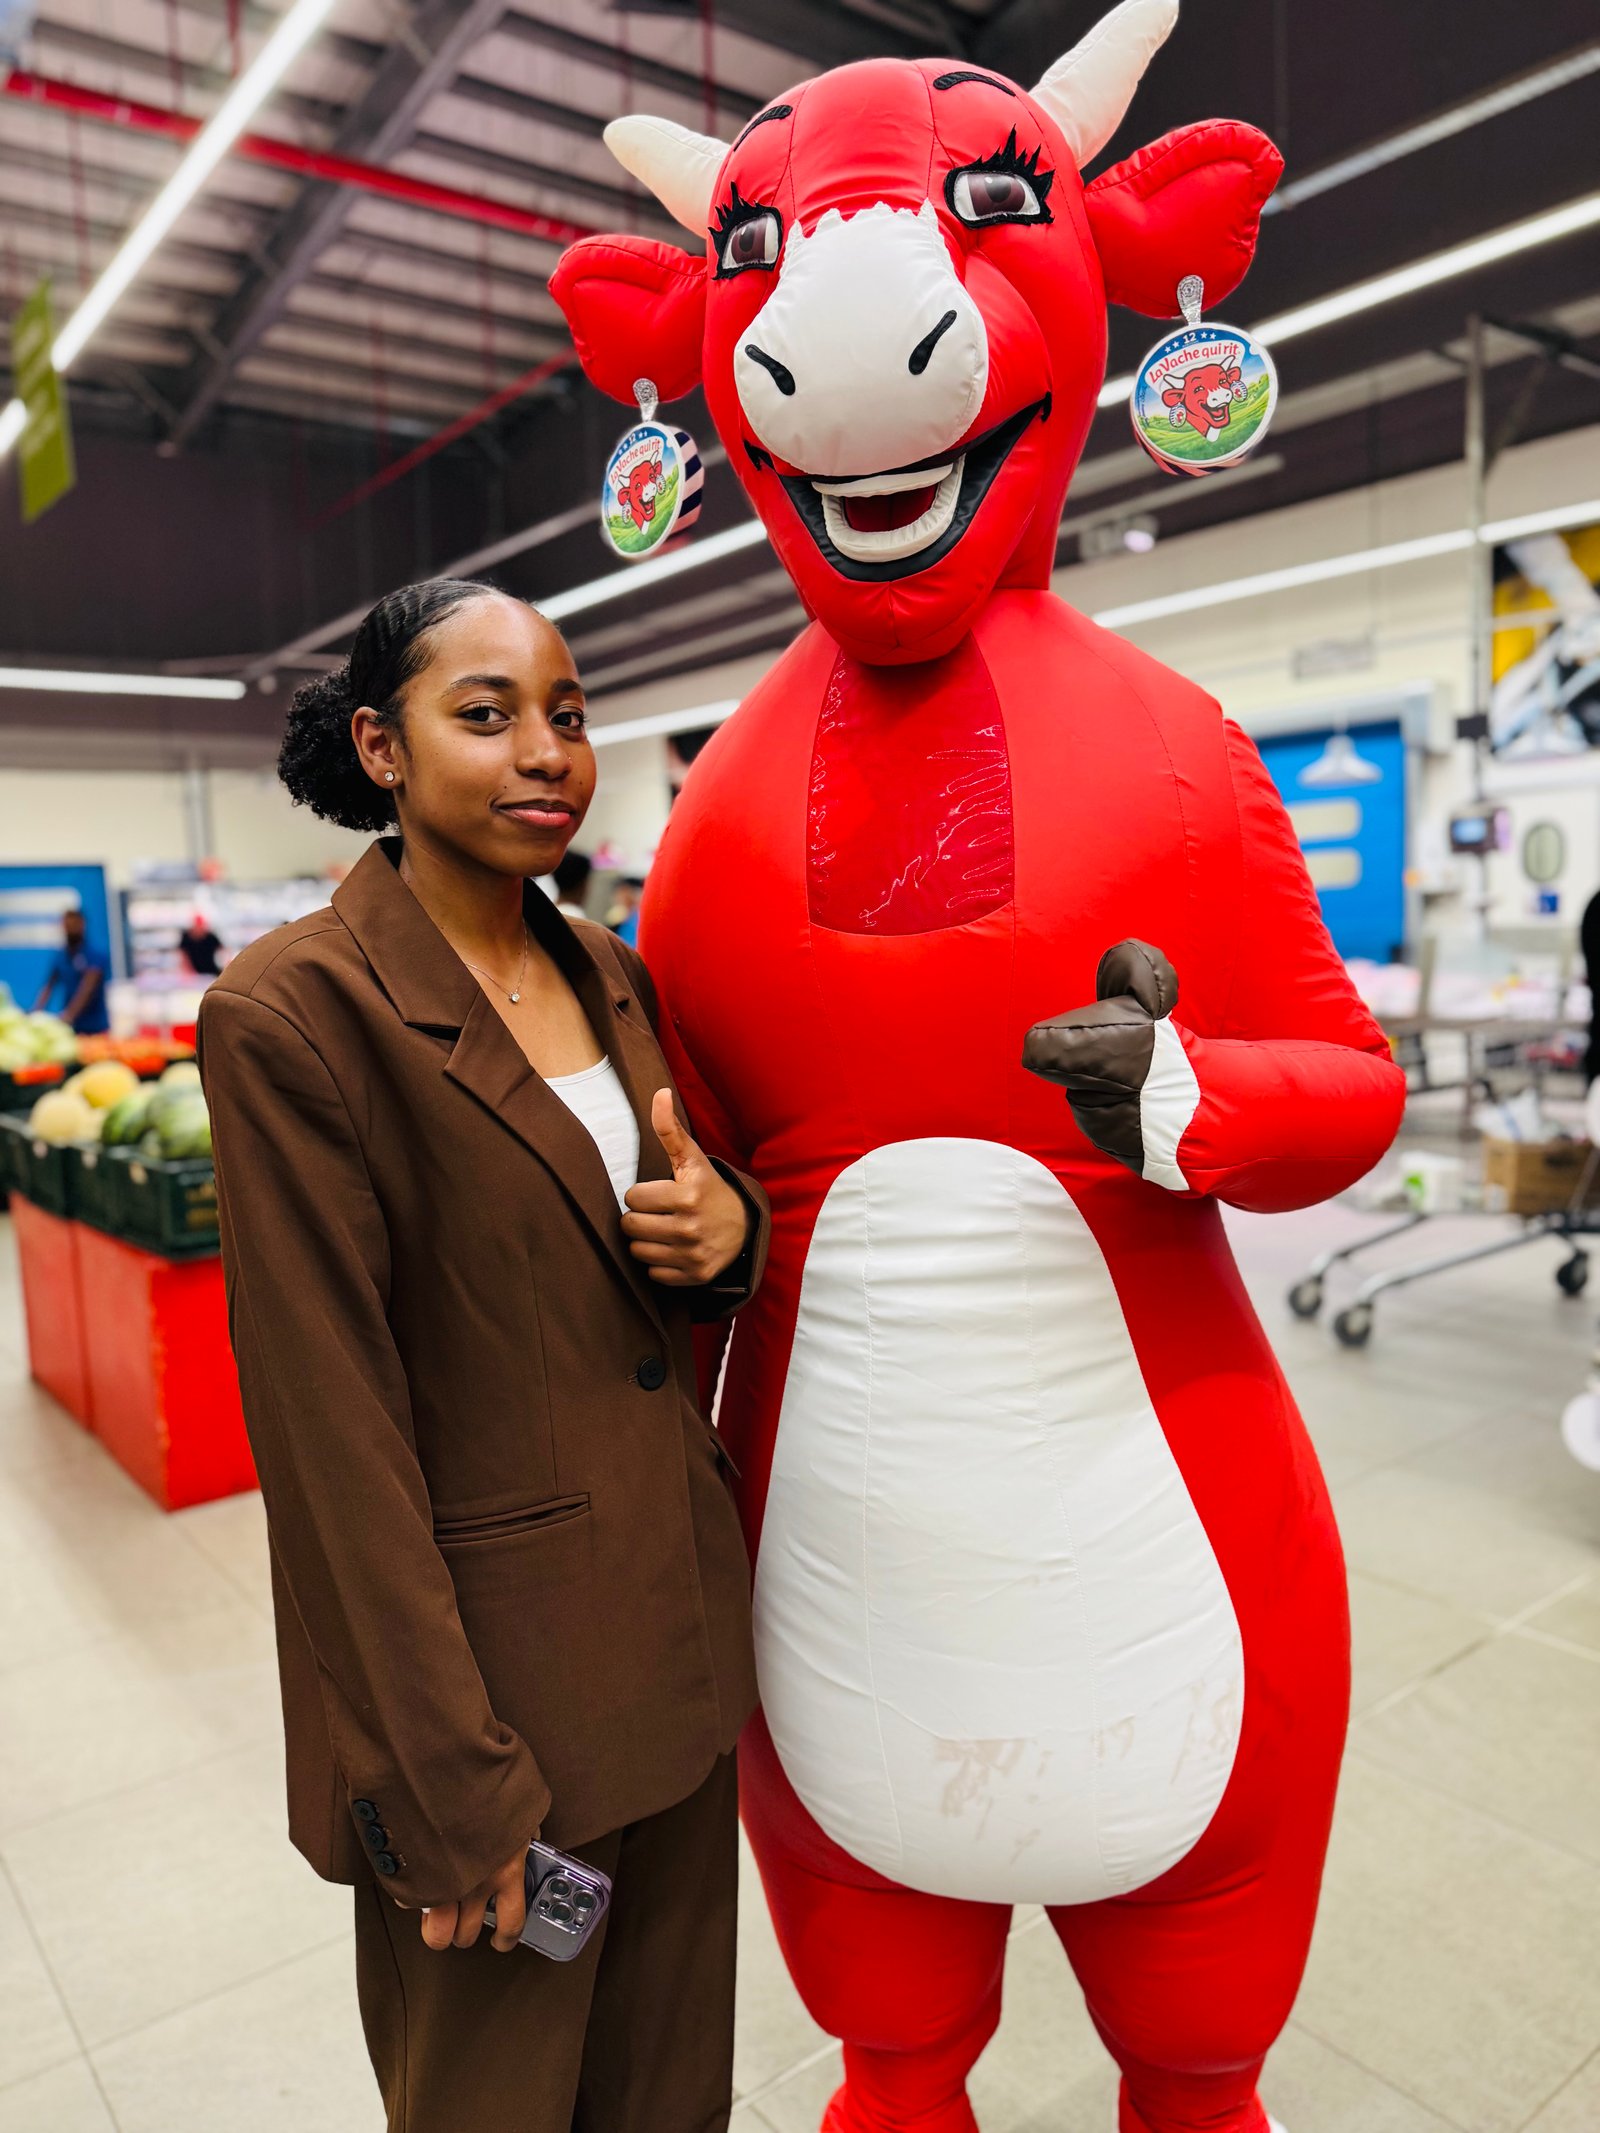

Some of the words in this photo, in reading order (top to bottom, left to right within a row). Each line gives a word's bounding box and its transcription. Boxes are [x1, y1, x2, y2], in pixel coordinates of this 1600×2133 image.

[1183, 332, 1197, 344] 12
[1149, 368, 1163, 384] La
[1159, 348, 1200, 372] Vache
[1202, 343, 1222, 357] qui
[1223, 341, 1240, 356] rit
[616, 448, 639, 473] Vache
[639, 439, 651, 455] qui
[651, 438, 661, 451] rit
